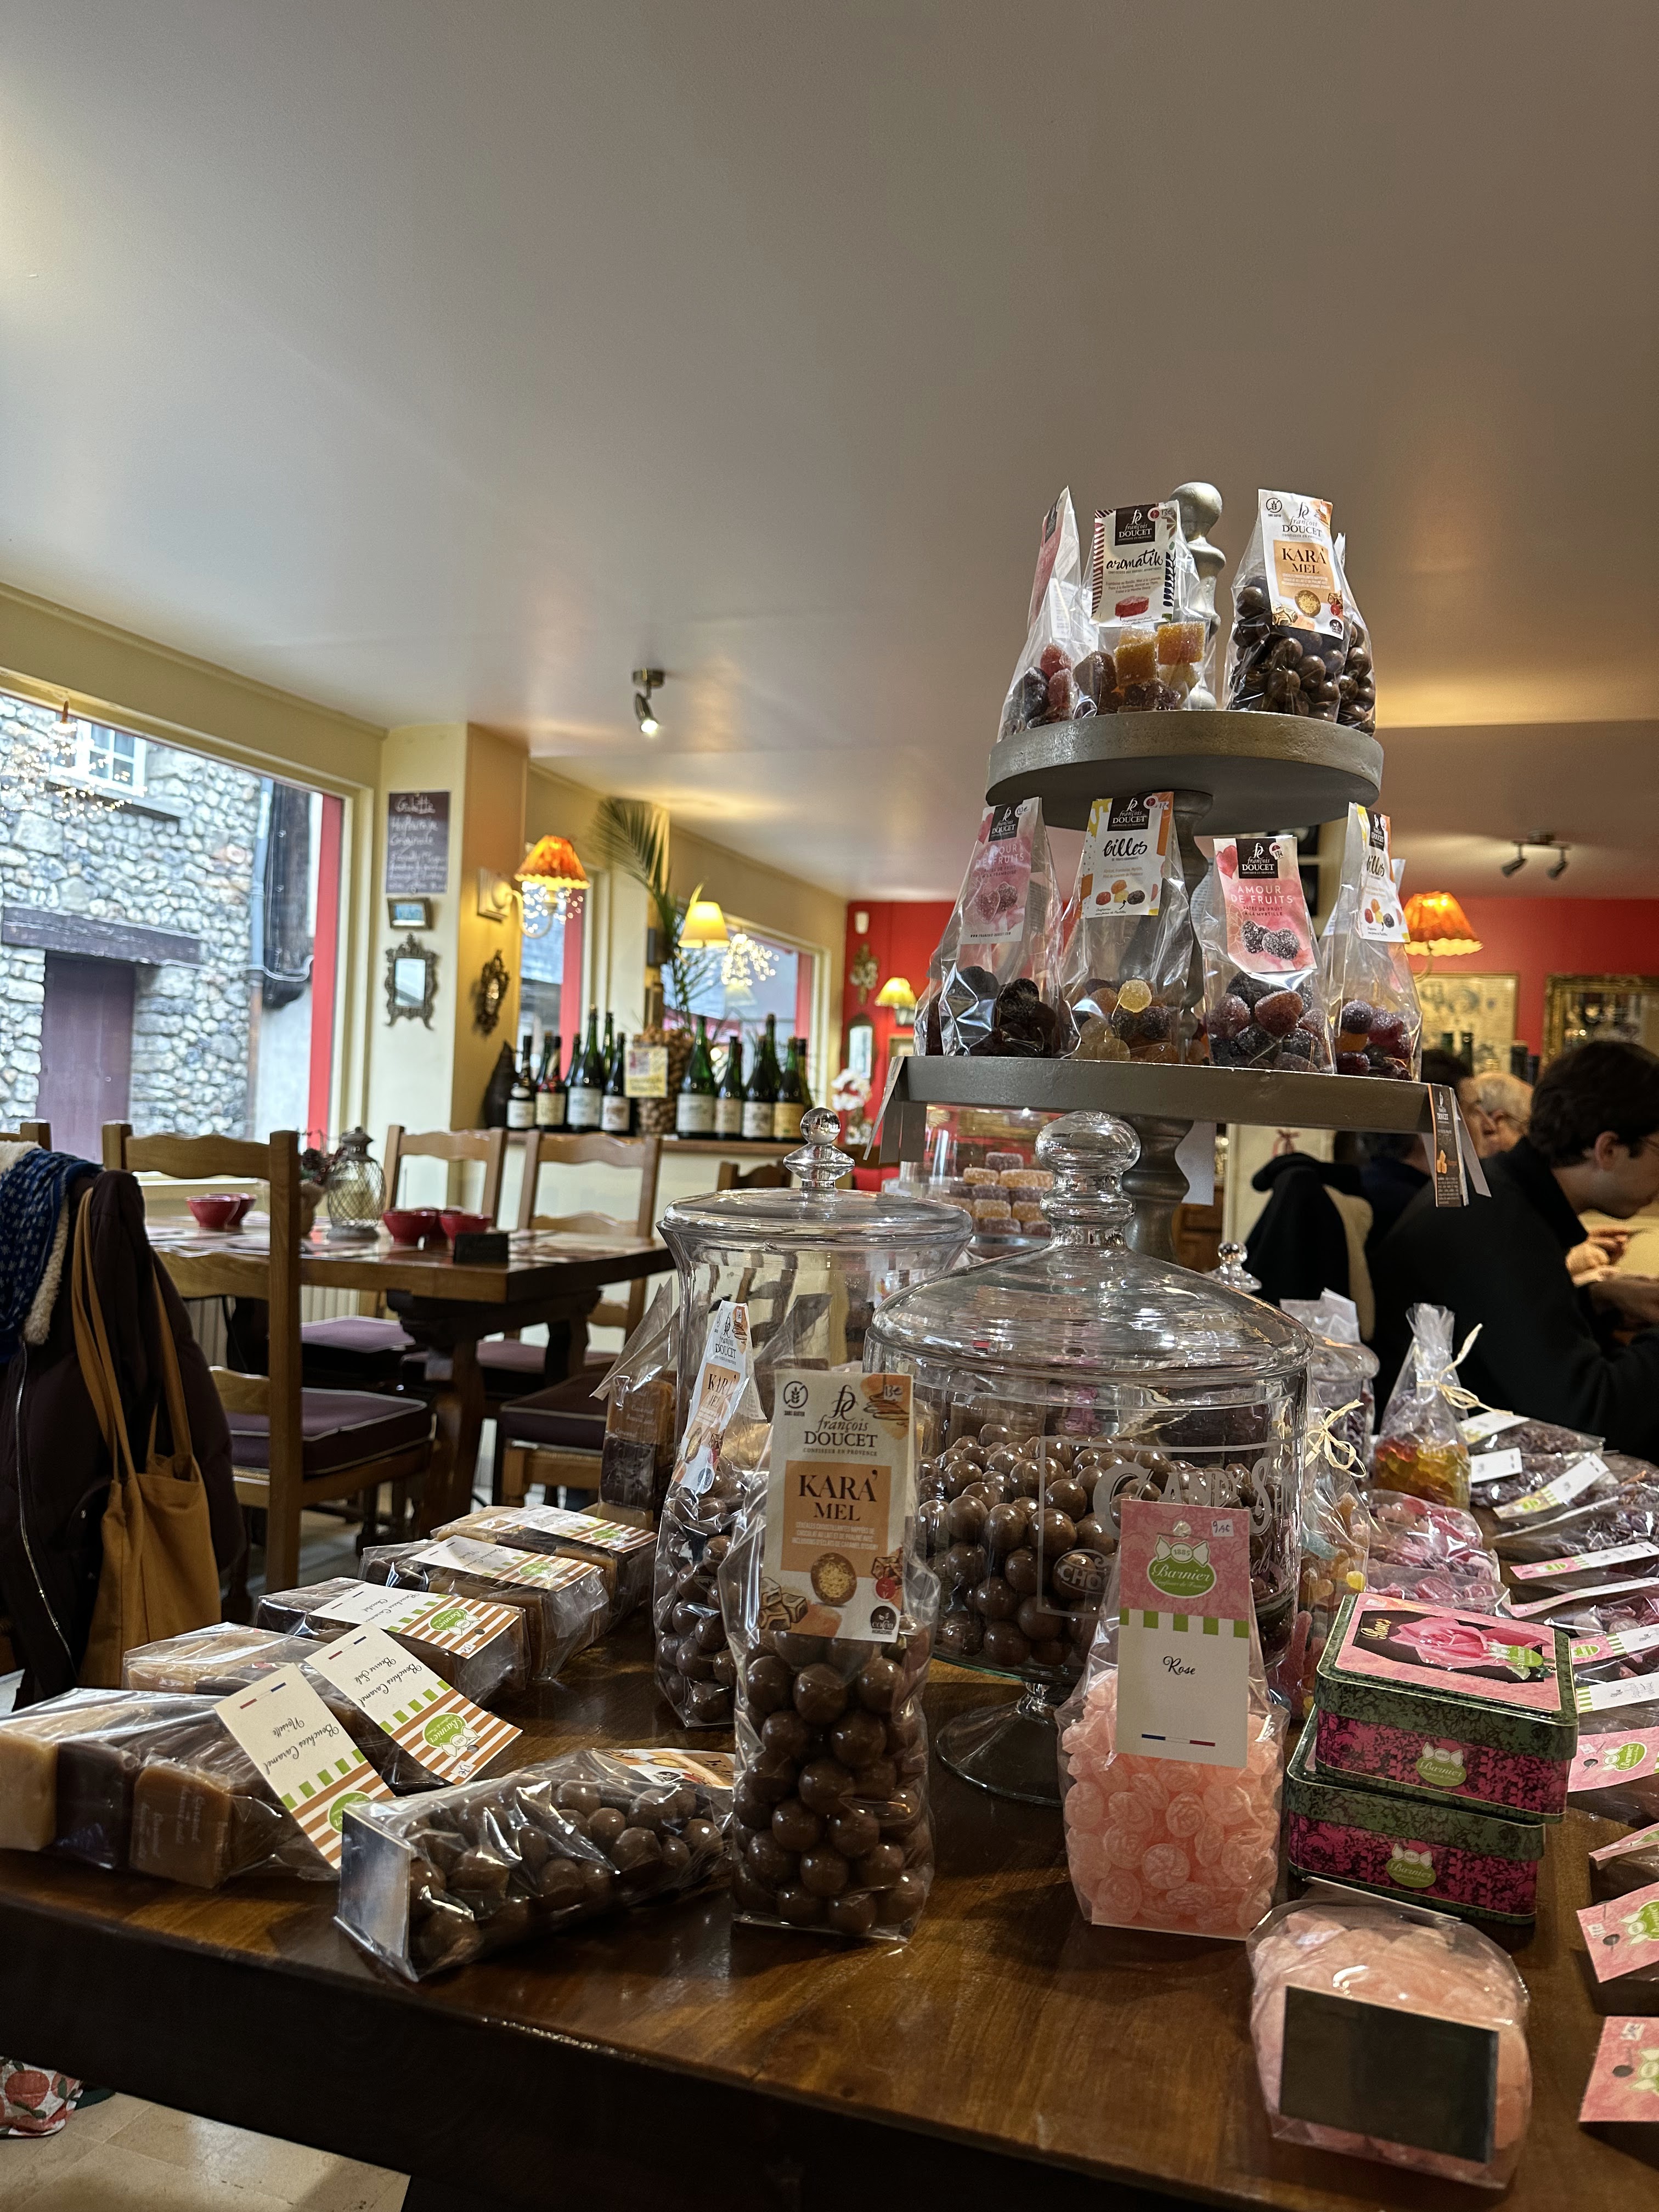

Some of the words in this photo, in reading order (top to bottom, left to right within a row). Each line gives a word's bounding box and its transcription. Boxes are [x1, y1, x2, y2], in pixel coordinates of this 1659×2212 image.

[1119, 528, 1152, 538] DOUCET
[1282, 524, 1322, 537] DOUCET
[1106, 549, 1163, 570] aromatik
[1292, 563, 1320, 574] MEL
[1113, 815, 1148, 823] DOUCET
[1118, 810, 1143, 819] françois
[992, 824, 1016, 834] DOUCET
[1103, 838, 1148, 857] billes
[992, 853, 1024, 865] FRUITS
[1247, 856, 1270, 865] françois
[1237, 885, 1282, 894] AMOUR
[1231, 894, 1245, 903] DE
[1250, 895, 1294, 904] FRUITS
[715, 1344, 737, 1359] DOUCET
[815, 1414, 869, 1433] françois
[804, 1431, 878, 1447] DOUCET
[813, 1502, 861, 1521] MEL
[1173, 1549, 1191, 1557] 1885
[1152, 1563, 1212, 1582] Barnier
[363, 1599, 388, 1612] Chocolat
[363, 1609, 392, 1623] Carame
[437, 1609, 465, 1629] Barnier
[369, 1656, 397, 1673] Beurre
[1163, 1656, 1196, 1675] Rose
[358, 1681, 390, 1708] Caramel
[272, 1717, 306, 1738] Noisette
[430, 1716, 464, 1744] Barnier
[262, 1743, 300, 1775] Caramel
[1620, 1745, 1634, 1769] Barnier
[1419, 1760, 1463, 1777] Barnier
[1389, 1863, 1432, 1878] Barnier
